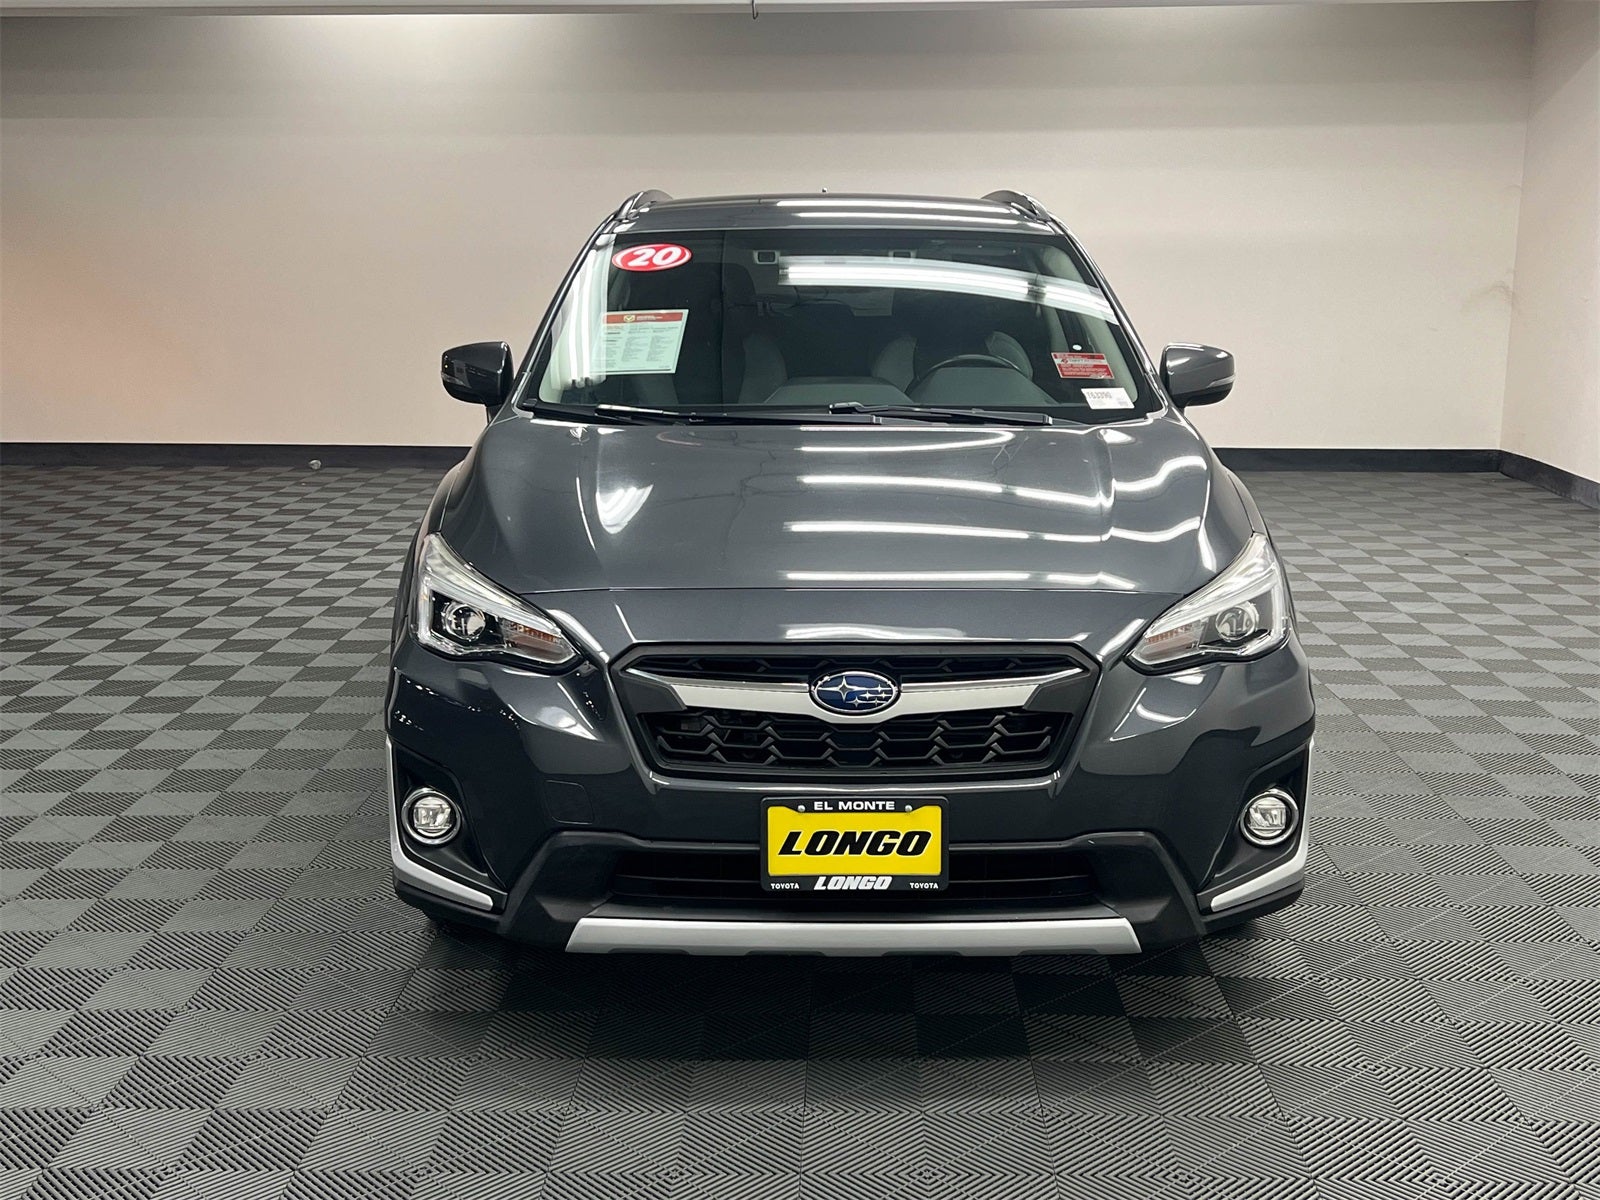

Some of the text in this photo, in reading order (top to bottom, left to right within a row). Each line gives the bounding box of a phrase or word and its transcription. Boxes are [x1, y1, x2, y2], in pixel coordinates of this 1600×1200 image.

[627, 246, 682, 267] 20
[813, 801, 895, 811] EL MONTE
[777, 831, 932, 857] LONGO
[813, 876, 893, 891] LONGO
